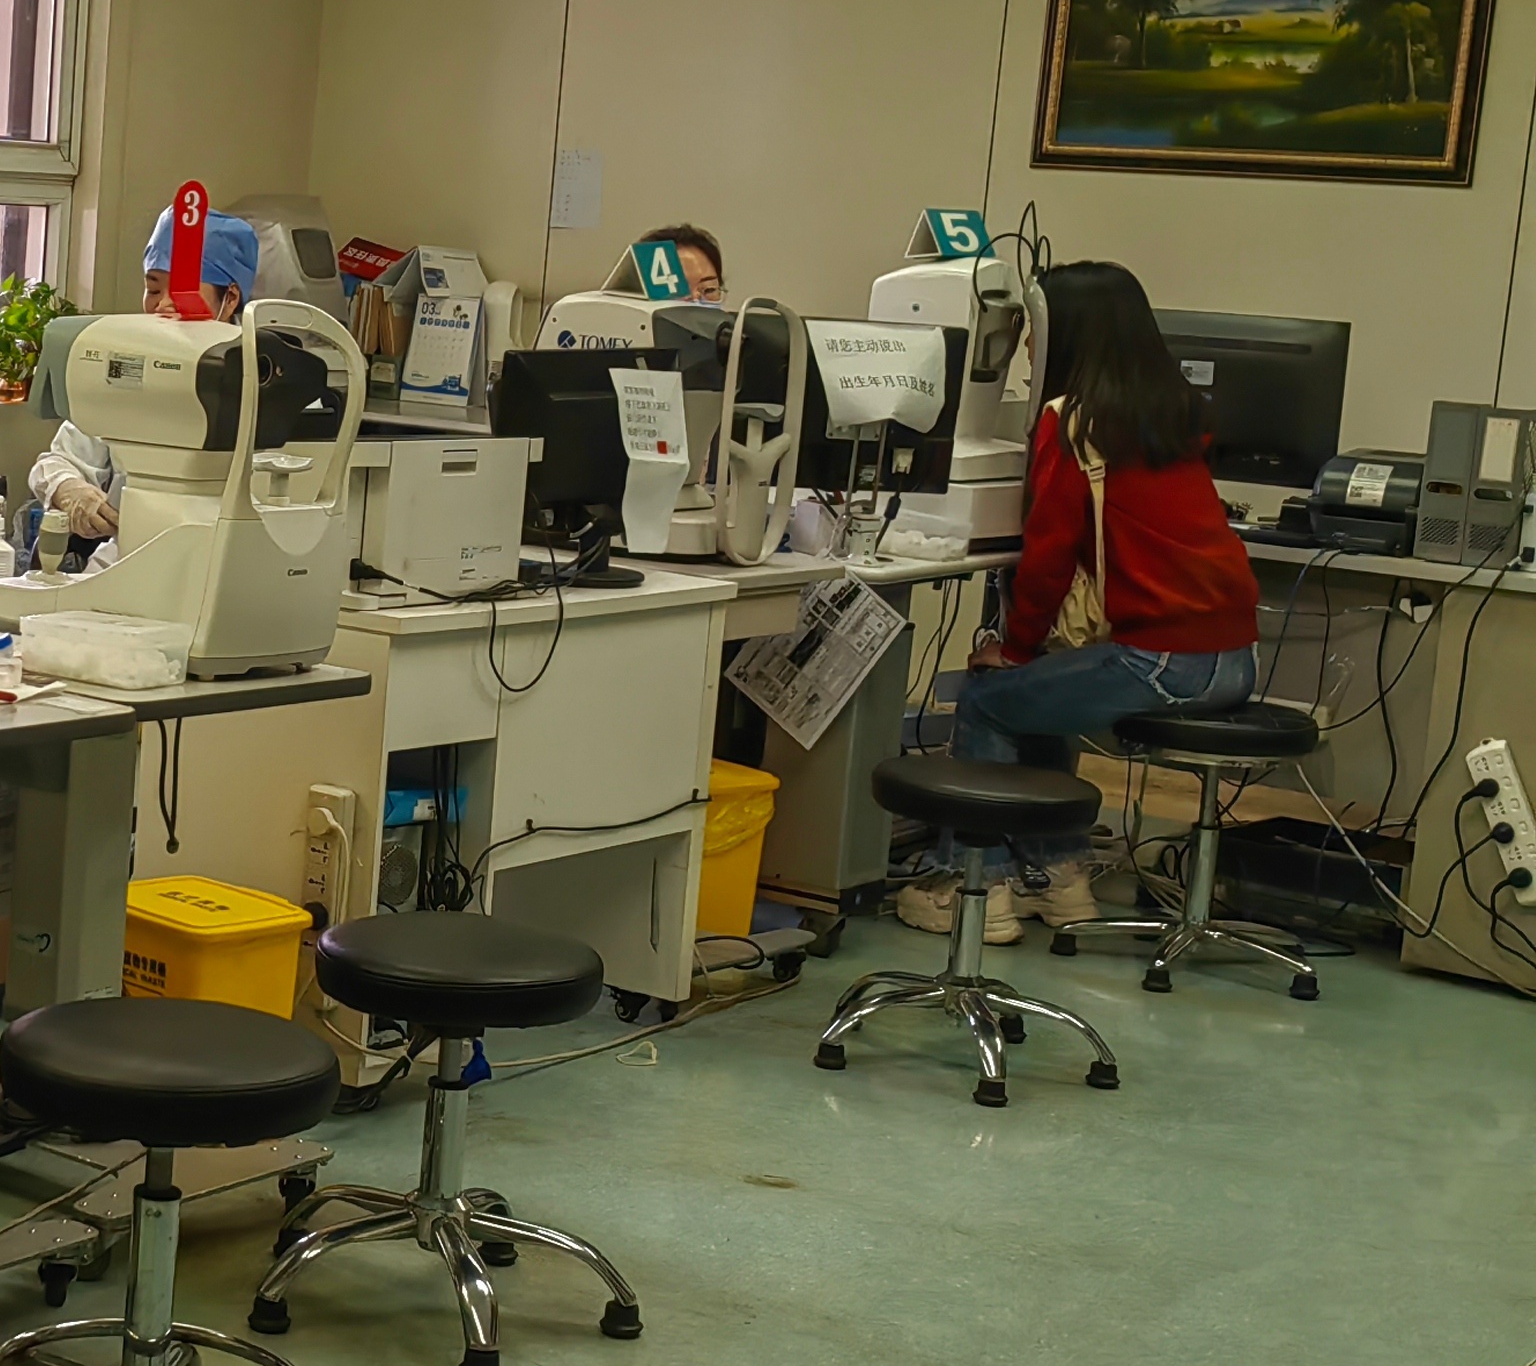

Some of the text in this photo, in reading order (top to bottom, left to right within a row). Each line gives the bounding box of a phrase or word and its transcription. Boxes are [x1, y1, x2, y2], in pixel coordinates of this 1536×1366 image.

[182, 190, 200, 226] 3
[940, 212, 979, 252] 5
[651, 247, 679, 294] 4
[825, 338, 907, 353] 请您主动说出
[839, 375, 936, 397] 出生年月日及姓名
